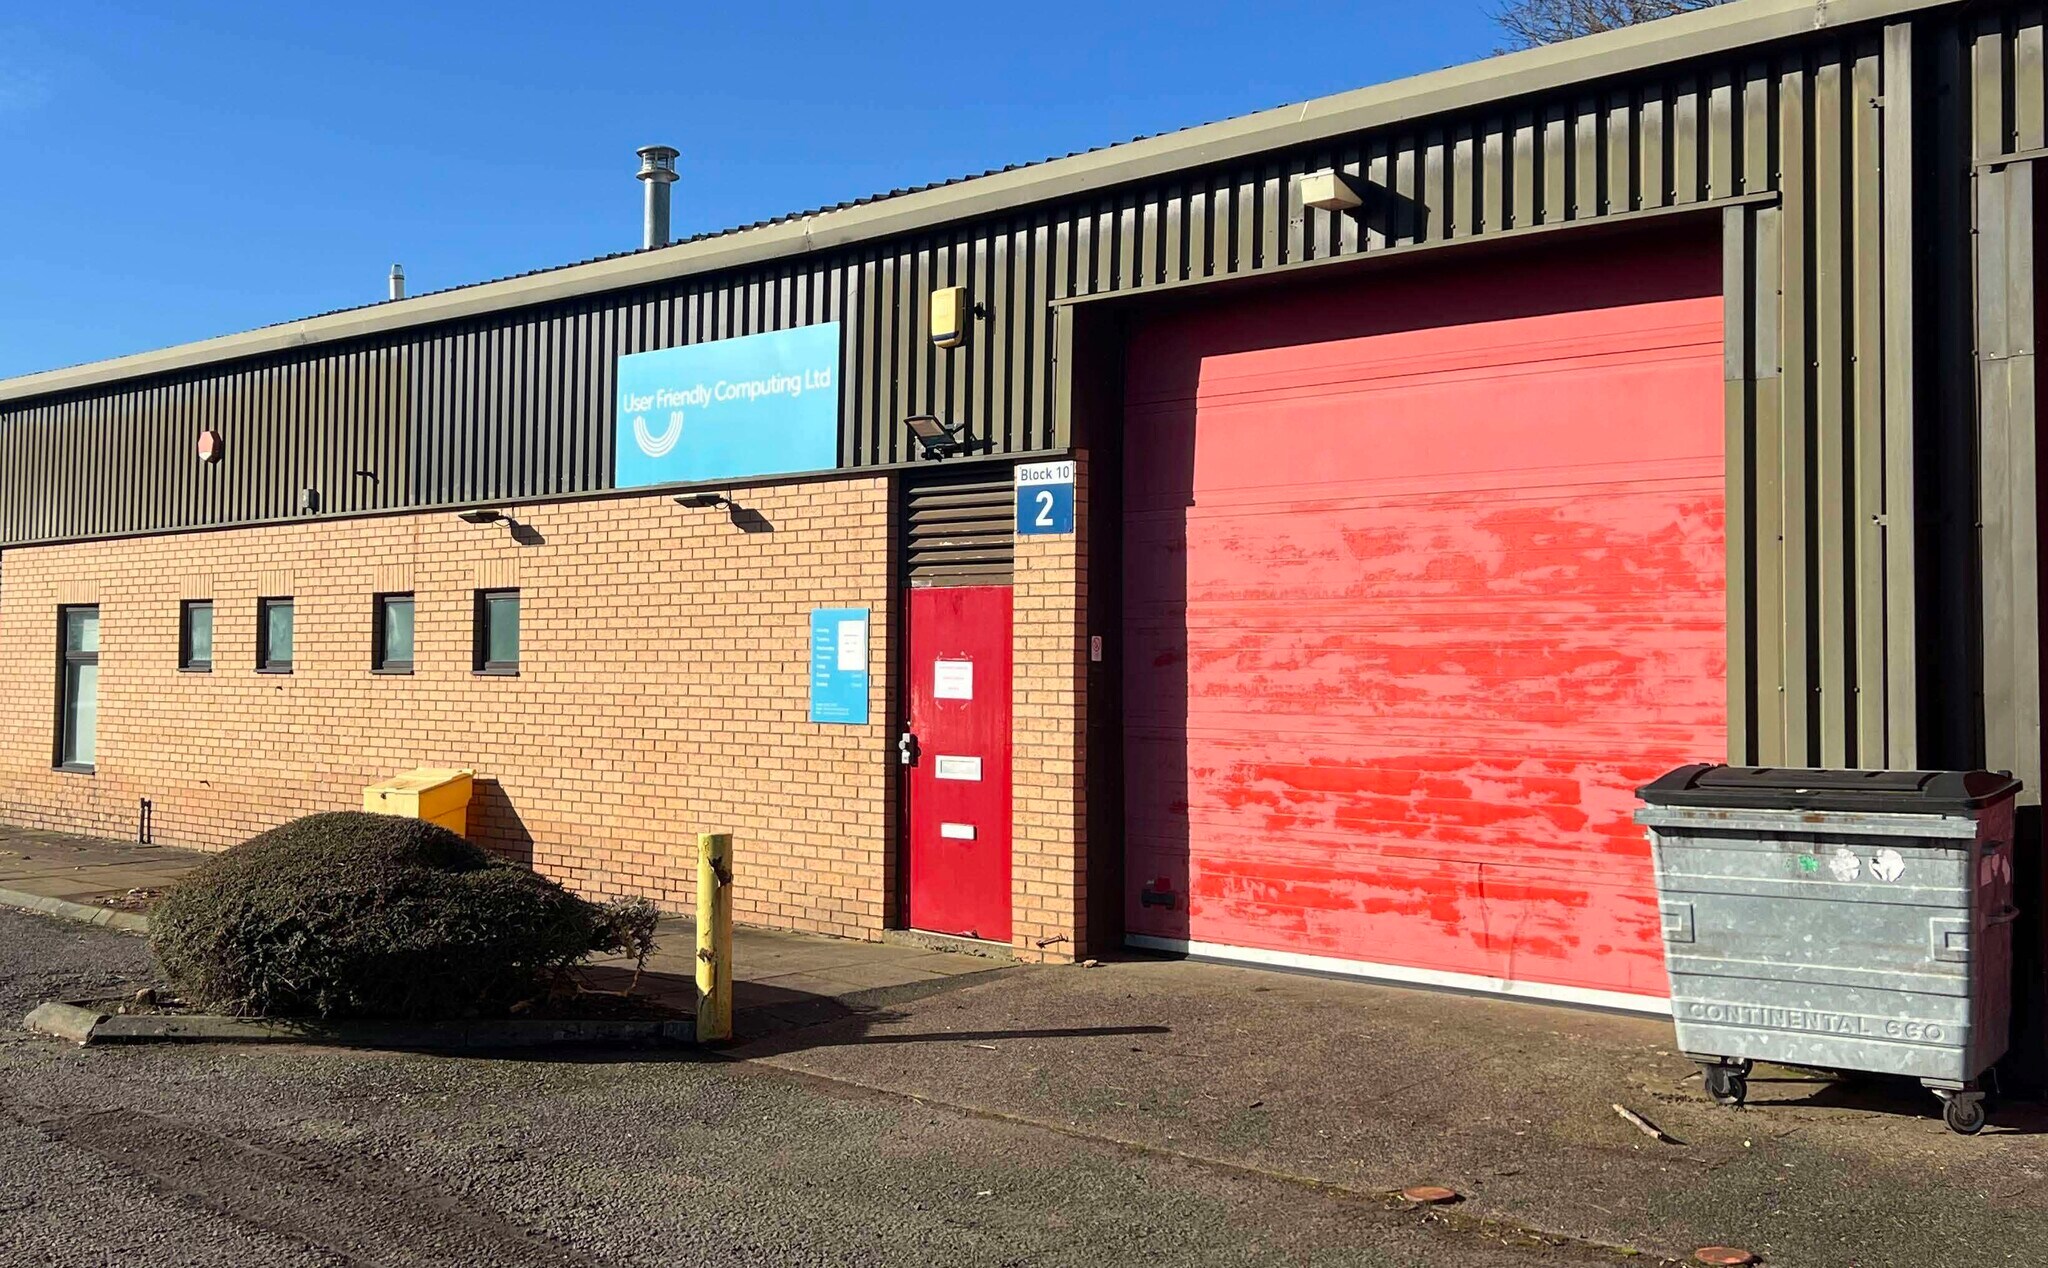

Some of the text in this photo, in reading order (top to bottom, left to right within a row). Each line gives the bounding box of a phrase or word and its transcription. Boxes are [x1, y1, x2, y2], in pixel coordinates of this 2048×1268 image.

[623, 366, 831, 413] User Friendly Computing Ltd
[1020, 465, 1070, 481] Block 10
[1035, 490, 1054, 527] 2
[1688, 1003, 1945, 1042] CONTINENTAL 660
